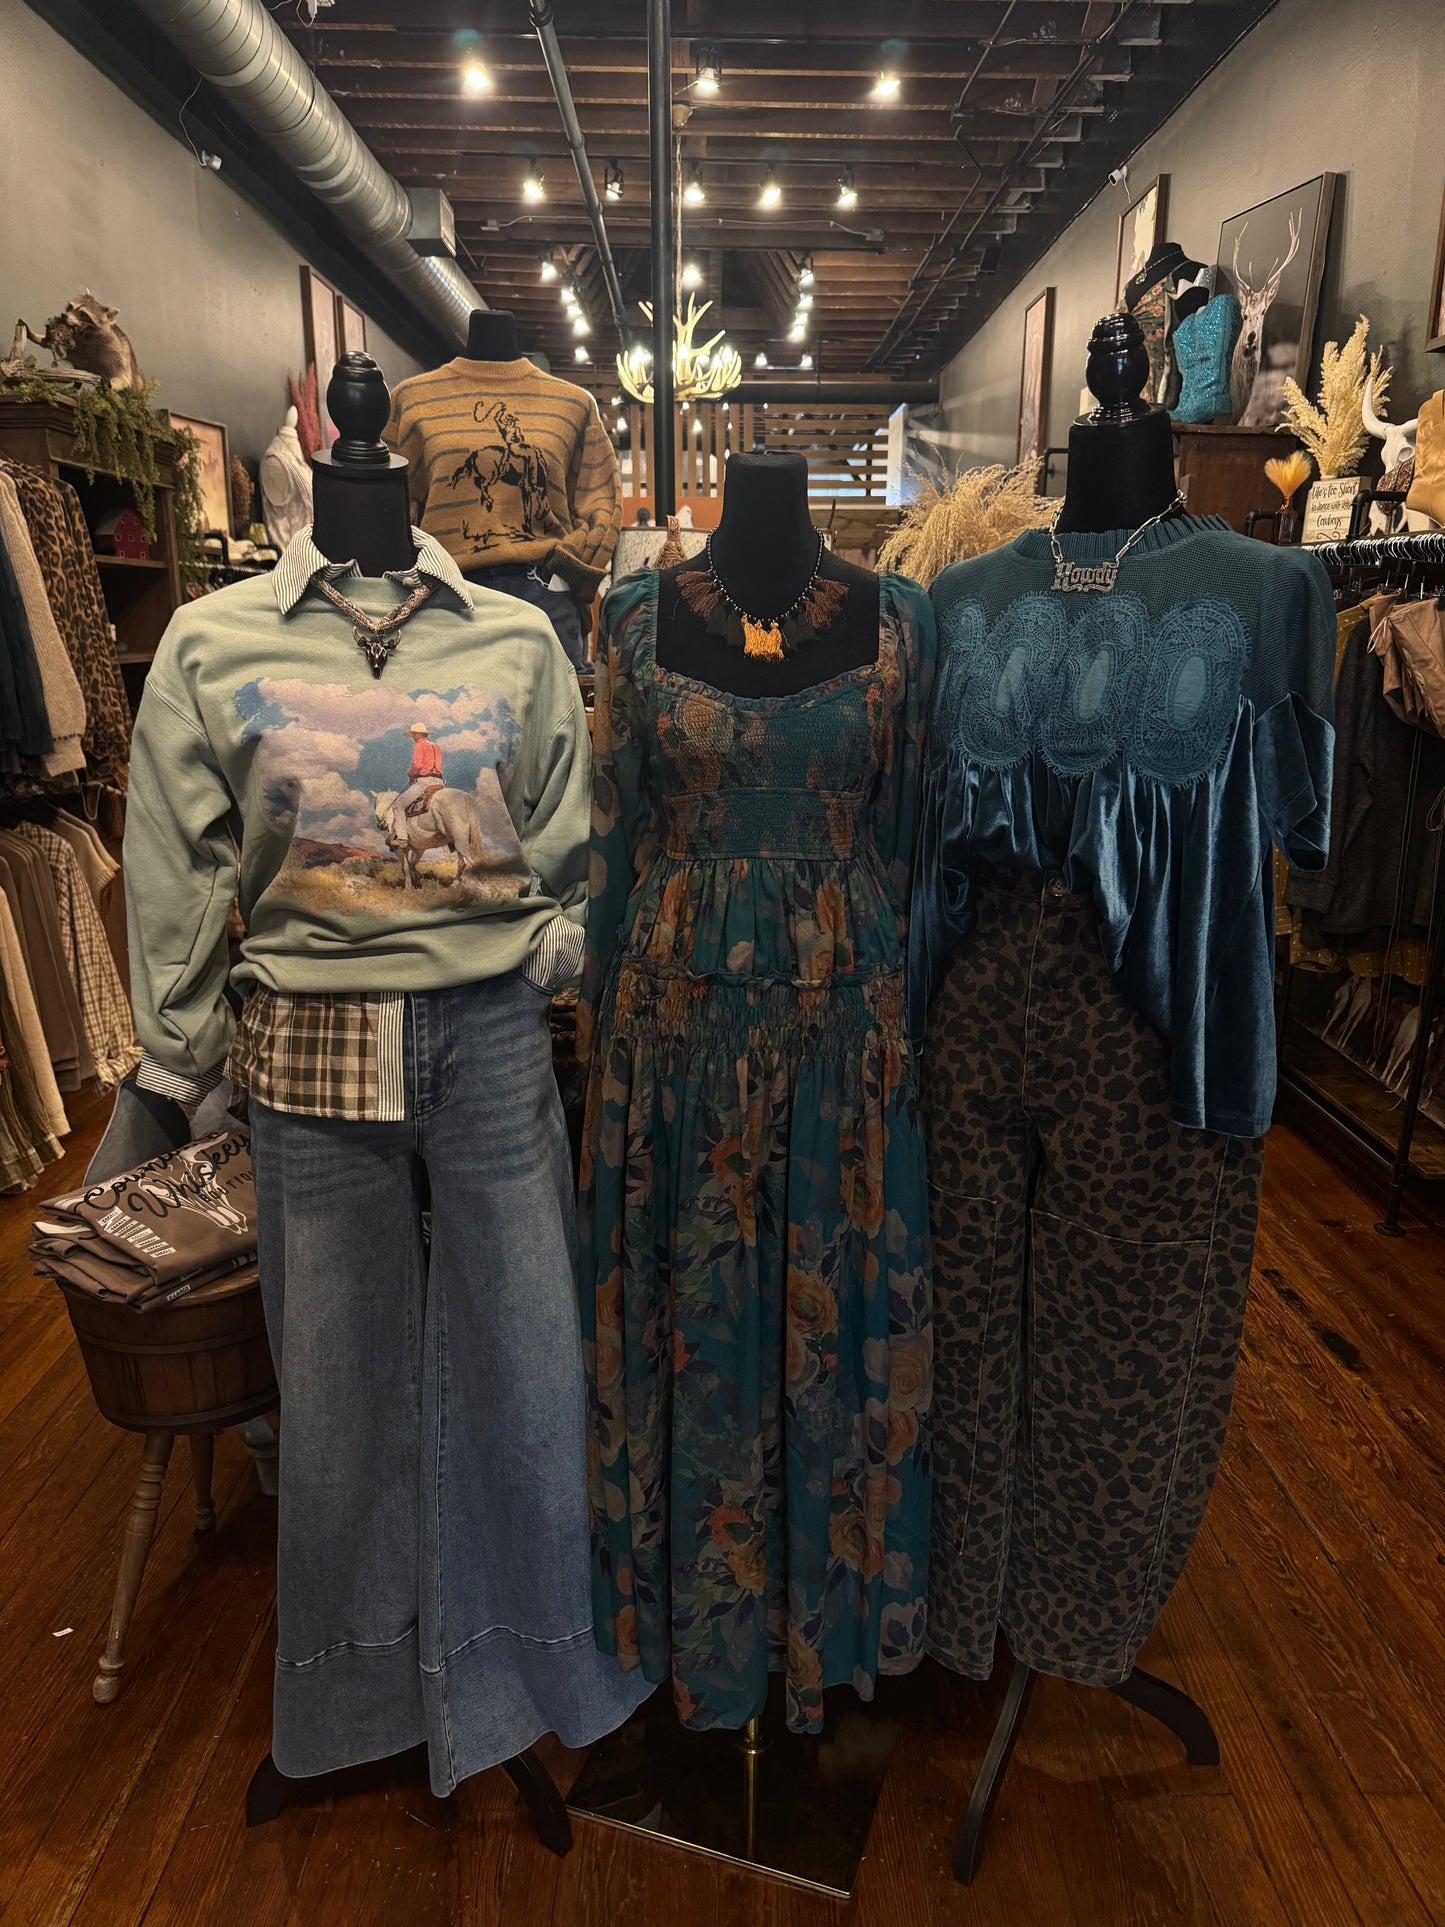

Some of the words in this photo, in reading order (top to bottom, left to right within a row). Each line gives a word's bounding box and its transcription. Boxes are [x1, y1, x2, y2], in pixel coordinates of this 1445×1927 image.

[1339, 480, 1359, 498] Short
[1051, 562, 1119, 592] Howdy
[199, 1171, 253, 1203] BOUTIQ
